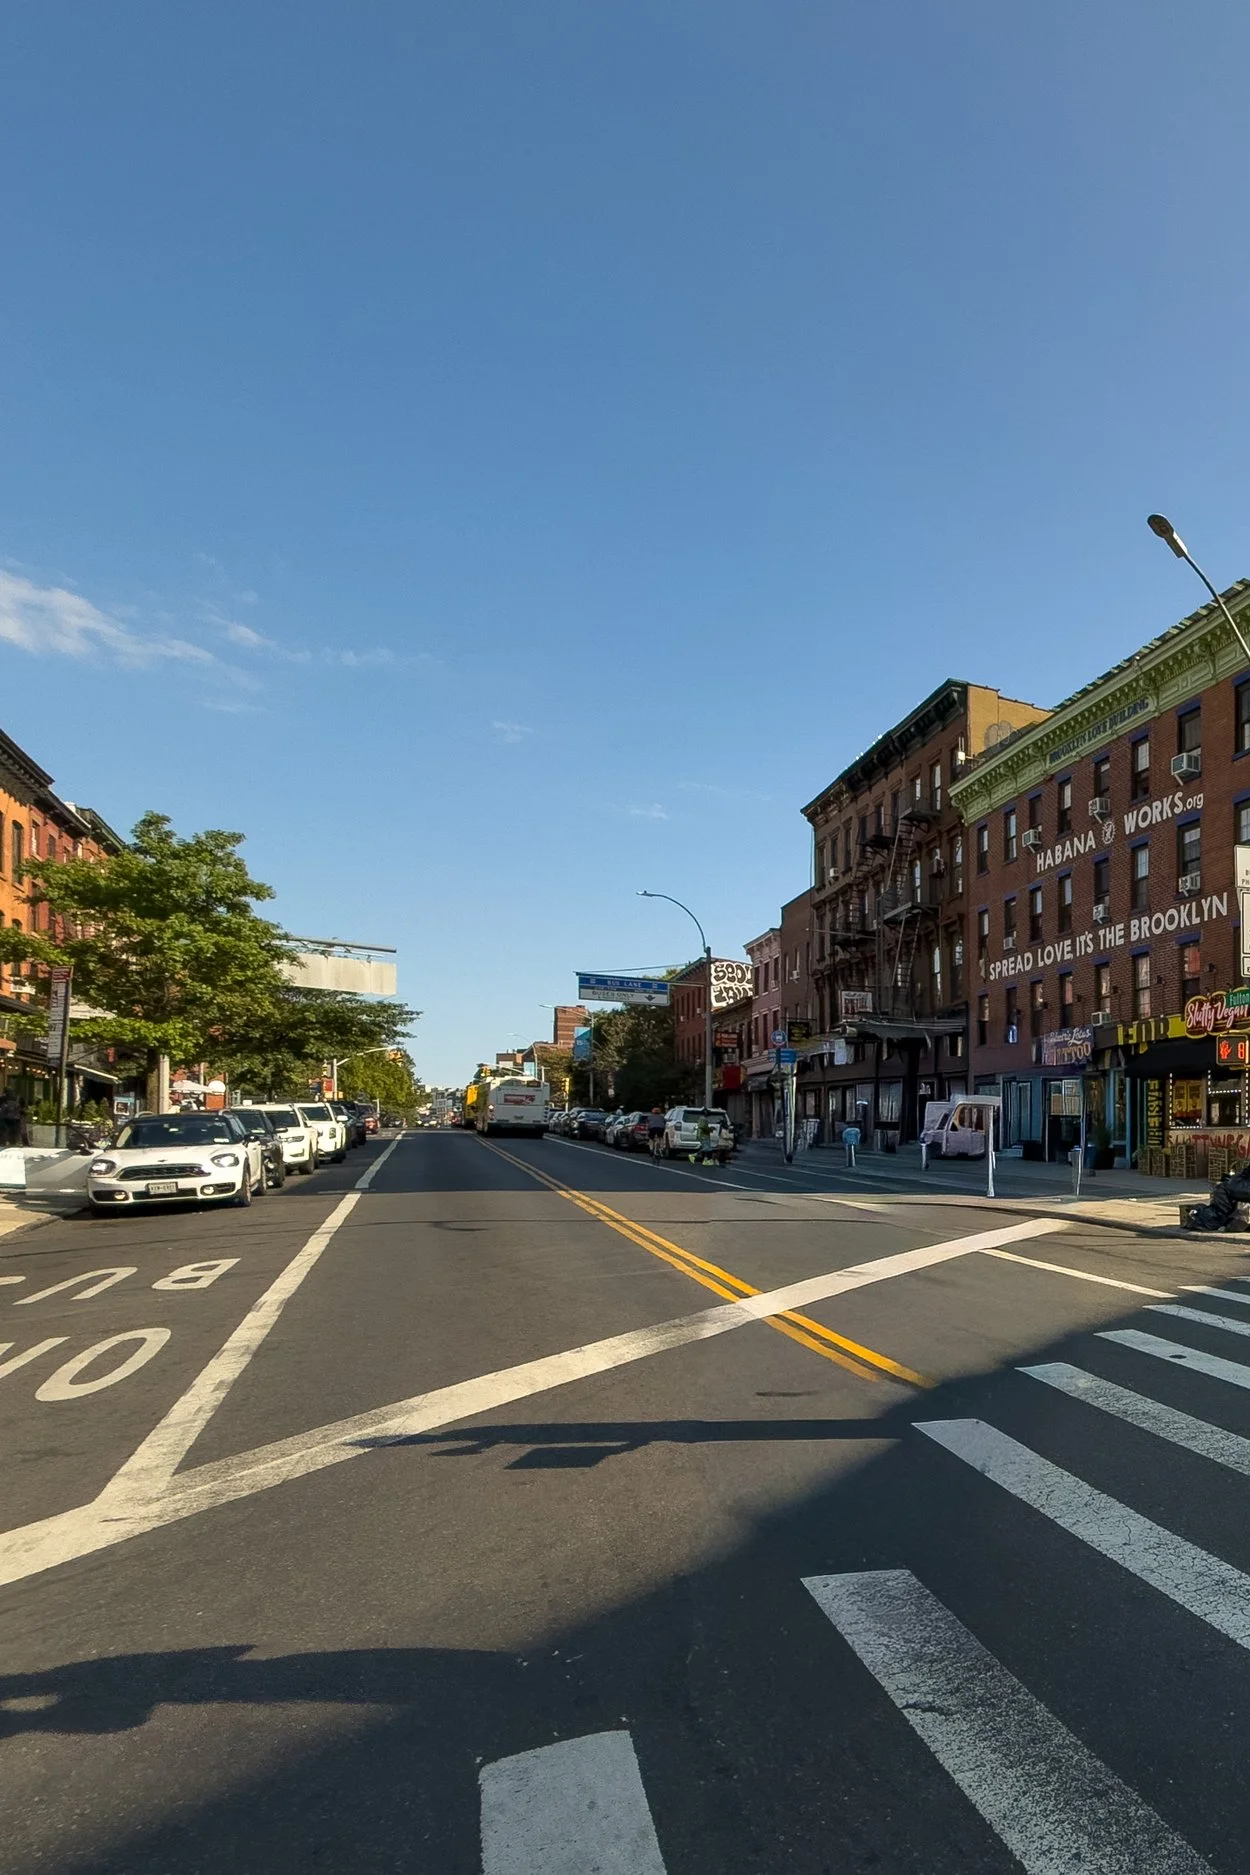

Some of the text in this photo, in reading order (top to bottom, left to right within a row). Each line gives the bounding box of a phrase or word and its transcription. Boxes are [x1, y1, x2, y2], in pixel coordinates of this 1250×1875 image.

[1036, 830, 1096, 873] HABANA
[989, 892, 1228, 981] SPREAD LOVE, IT'S THE BROOKLYN
[1186, 1001, 1249, 1031] Slutty Vegan
[1229, 993, 1250, 1006] Fulton
[1237, 1042, 1245, 1059] 8
[0, 1258, 241, 1306] BU
